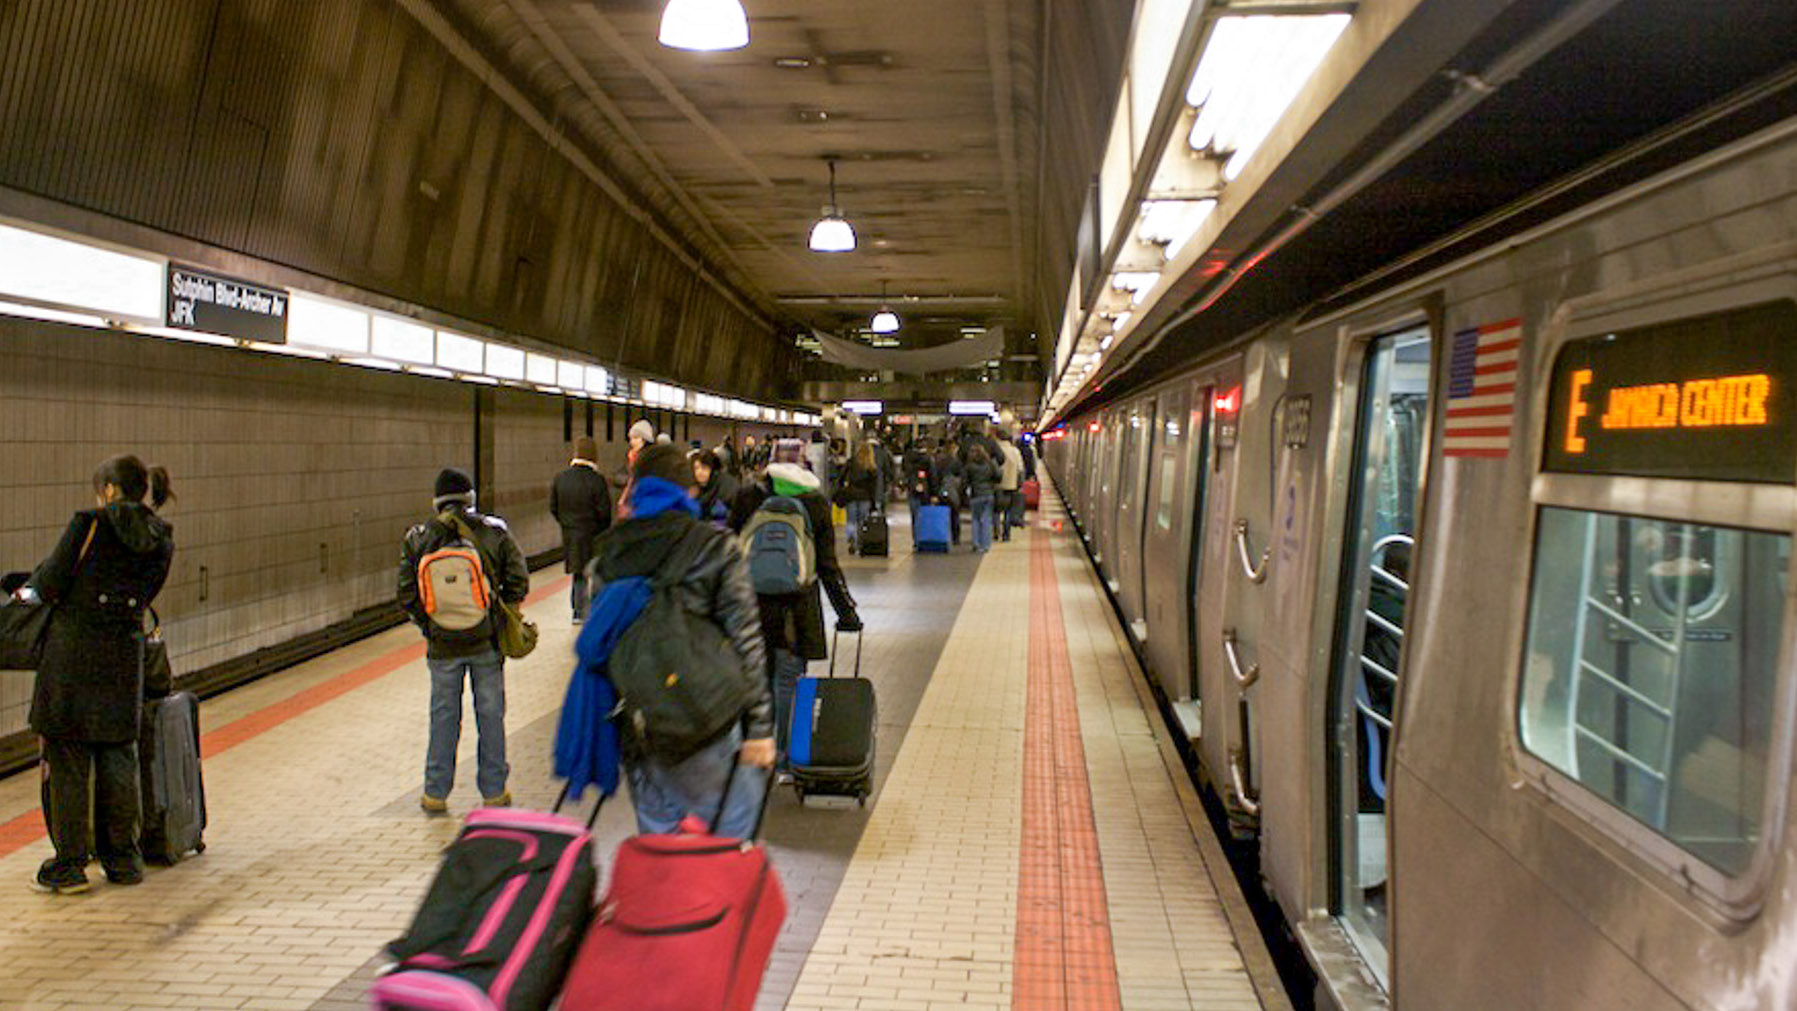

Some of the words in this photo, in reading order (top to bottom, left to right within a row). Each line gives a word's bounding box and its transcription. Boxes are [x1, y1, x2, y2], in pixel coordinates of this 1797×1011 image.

[172, 272, 214, 303] Sutphin
[171, 300, 195, 326] JFK
[1565, 368, 1593, 453] E
[1680, 374, 1770, 427] CENTER
